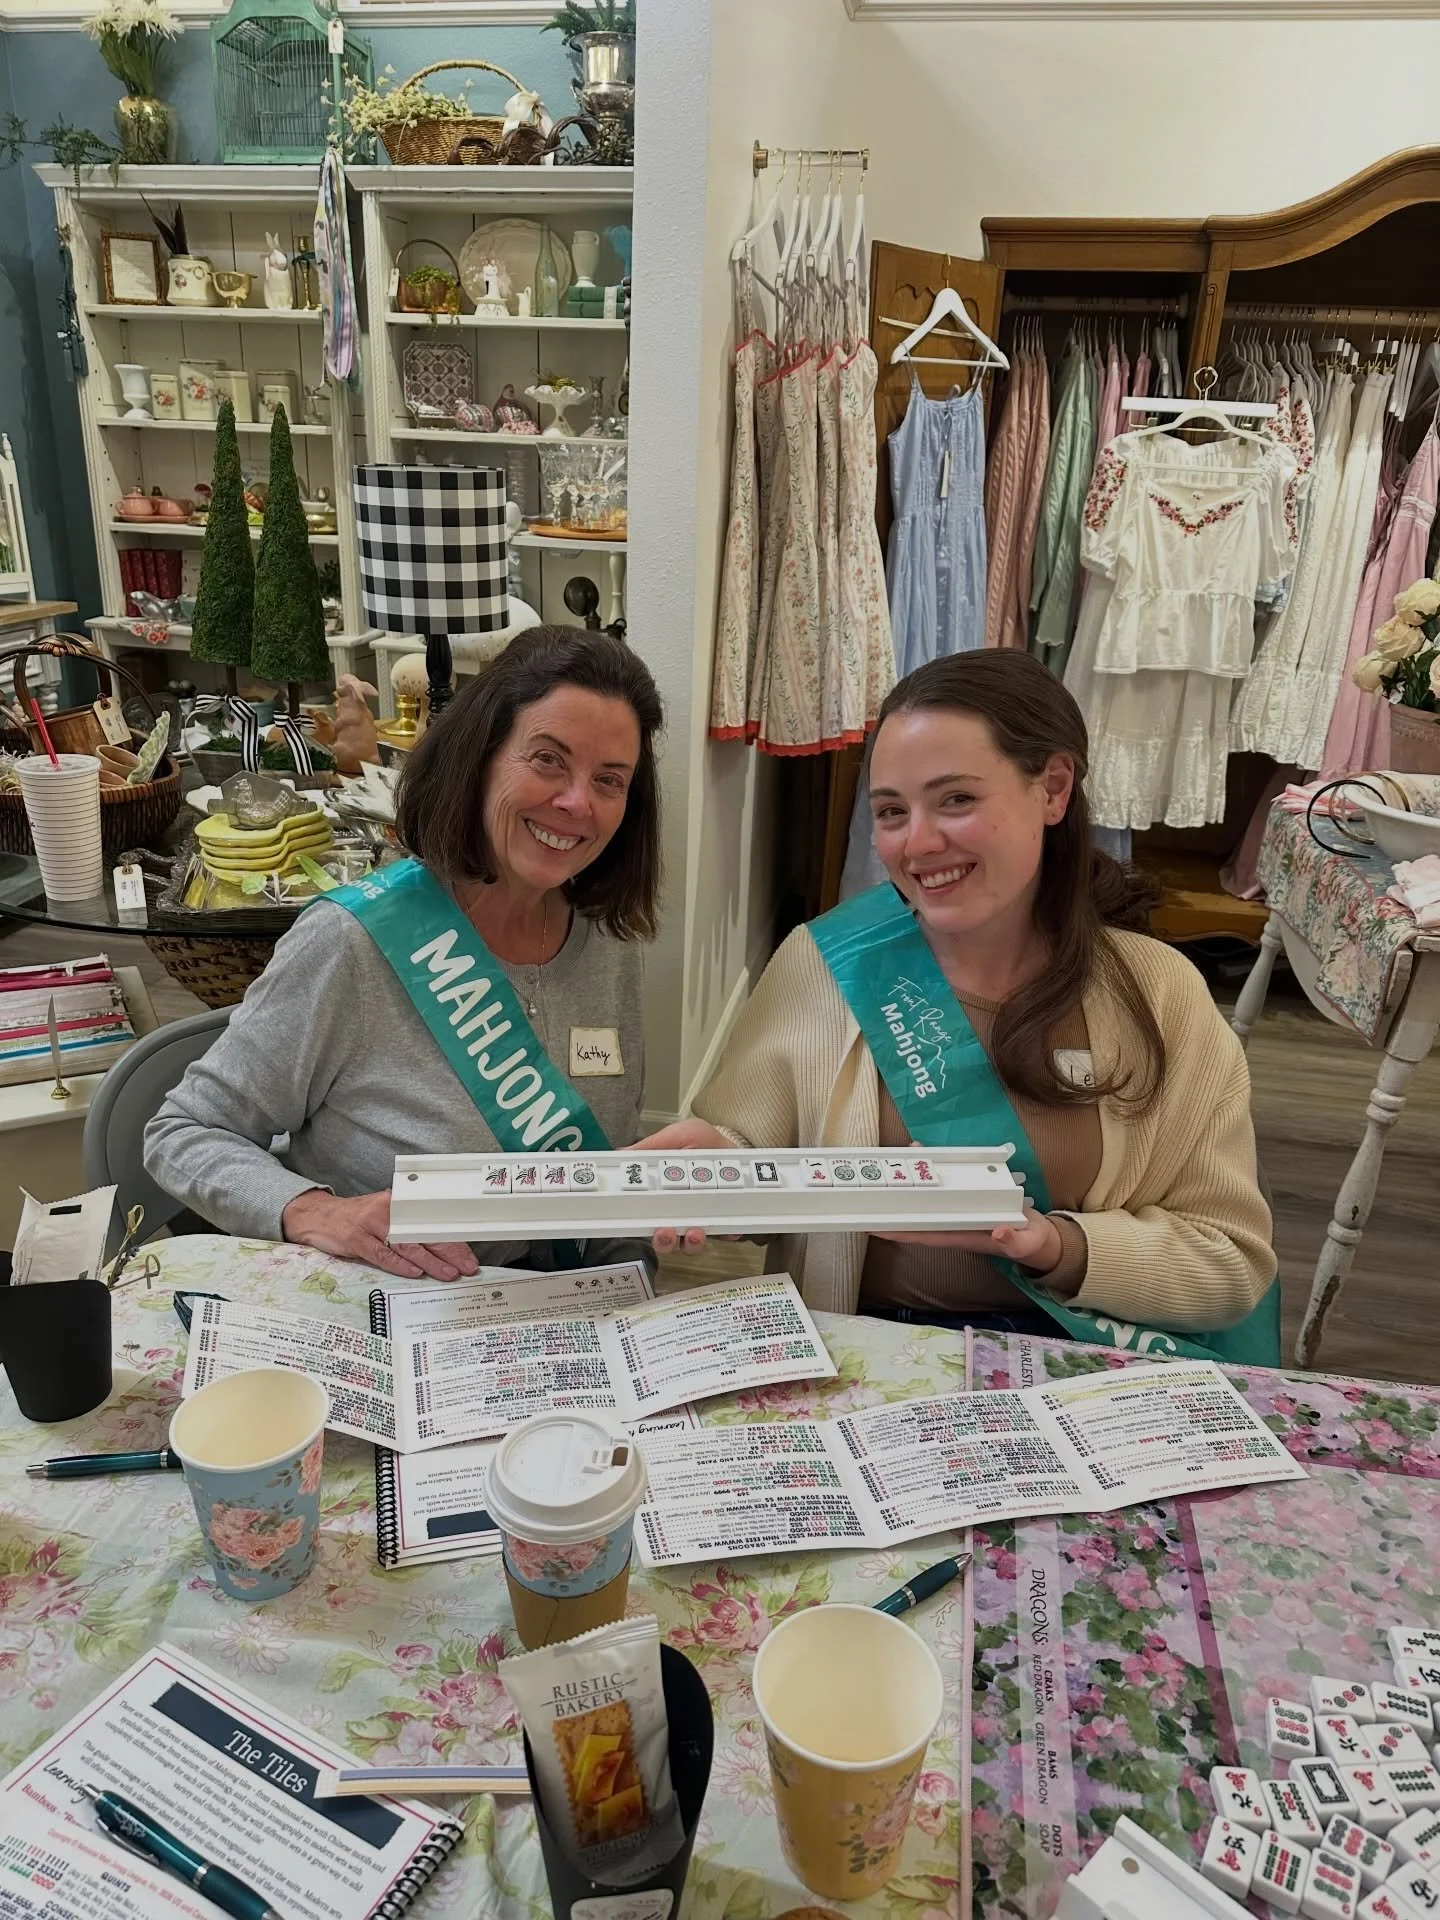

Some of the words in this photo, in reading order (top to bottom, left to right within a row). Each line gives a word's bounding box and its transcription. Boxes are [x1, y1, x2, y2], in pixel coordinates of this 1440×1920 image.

[888, 976, 929, 1013] Front
[912, 1007, 953, 1044] Range
[576, 1042, 611, 1067] Kathy
[880, 1002, 938, 1100] Mahjong
[639, 1421, 684, 1433] Learning
[960, 1477, 1006, 1487] CONSECUTIVE
[1101, 1481, 1125, 1490] VALUES
[886, 1520, 915, 1530] VALUES
[728, 1542, 765, 1550] DRAGONS
[1030, 1568, 1049, 1648] DRAGONS:
[1032, 1653, 1041, 1672] RED
[552, 1672, 623, 1699] RUSTIC
[1033, 1674, 1045, 1715] DRAGON
[1044, 1669, 1055, 1702] CRAKS
[555, 1686, 624, 1717] BAKERY
[1034, 1721, 1047, 1759] GREEN
[225, 1731, 261, 1763] The
[262, 1753, 307, 1792] Tiles
[1047, 1750, 1059, 1780] BAMS
[43, 1758, 90, 1803] Learning
[1036, 1760, 1048, 1805] DRAGON
[21, 1783, 58, 1813] Bamboos
[1039, 1822, 1050, 1853] SOAP
[1051, 1824, 1063, 1858] DOTS
[101, 1872, 130, 1892] QUINTS
